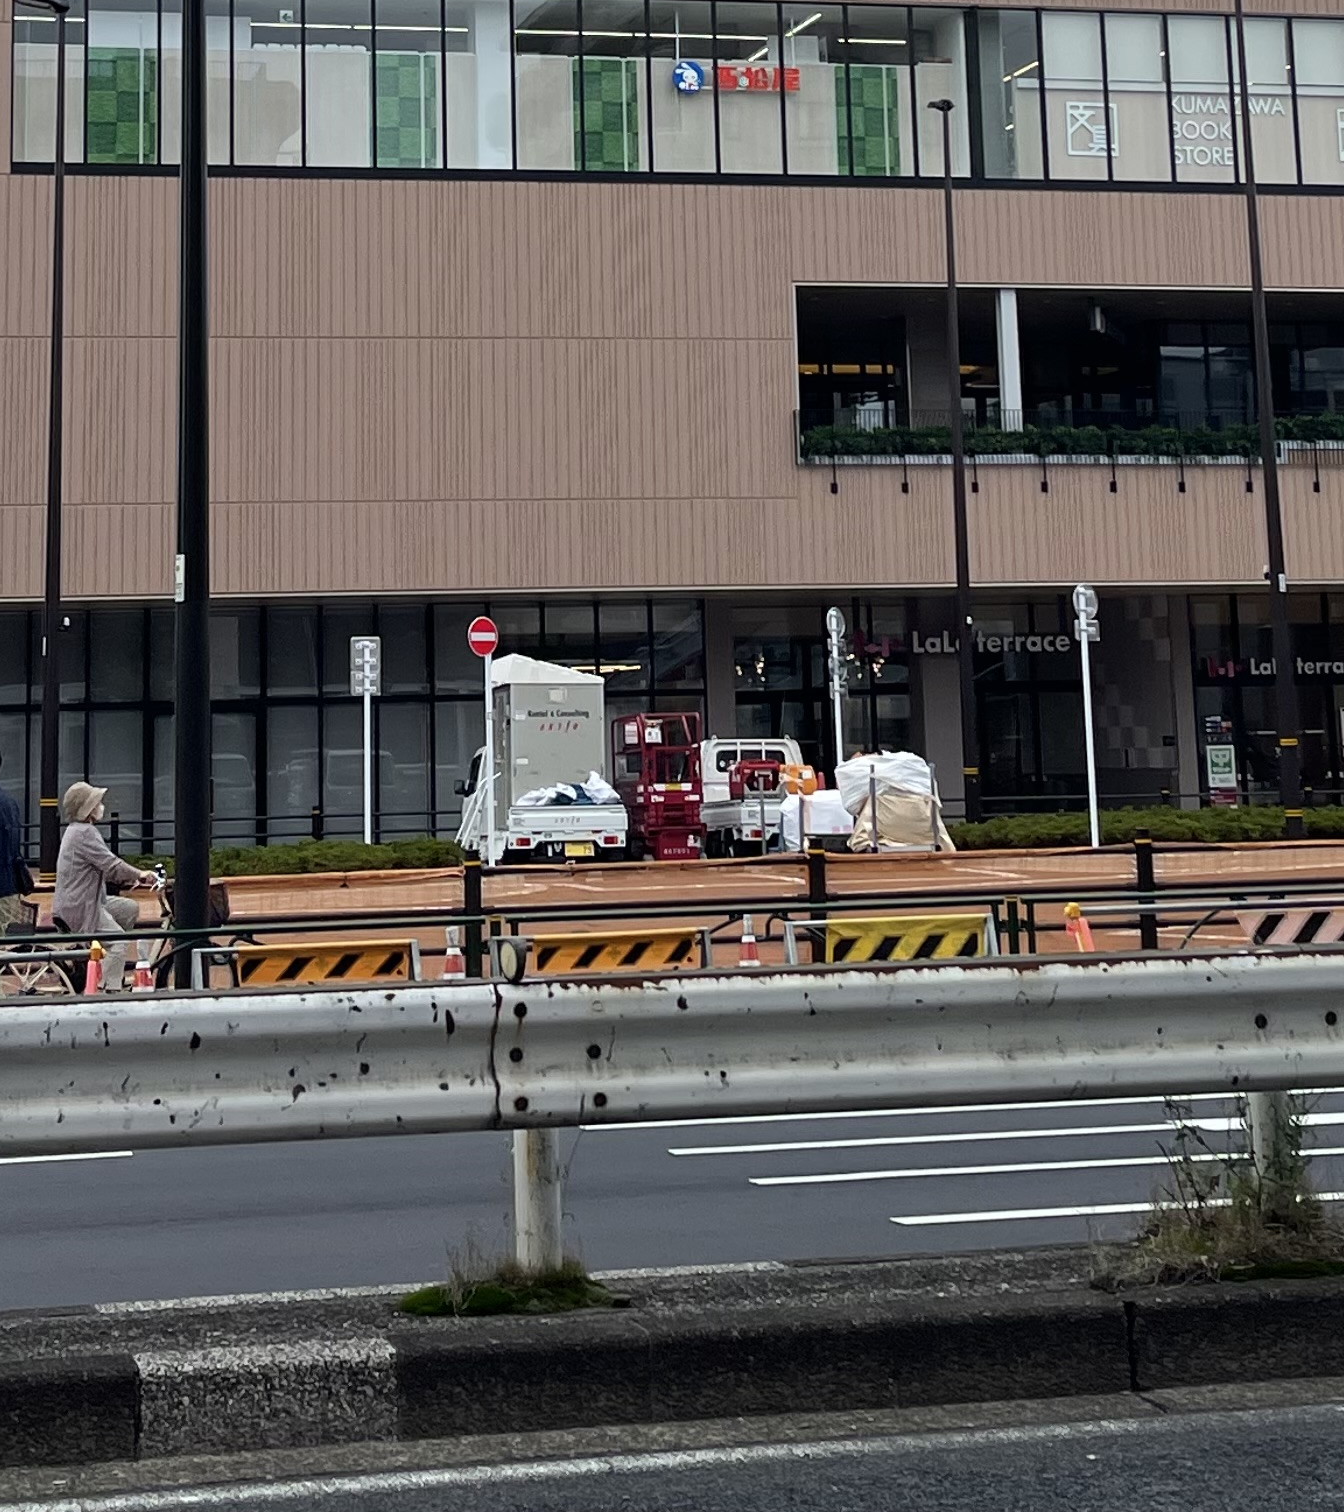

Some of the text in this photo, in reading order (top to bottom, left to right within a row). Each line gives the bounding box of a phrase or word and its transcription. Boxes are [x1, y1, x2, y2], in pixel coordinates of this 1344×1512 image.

[1172, 120, 1233, 140] BOOK
[1174, 145, 1234, 165] STORE
[911, 630, 1071, 654] LaL terrace
